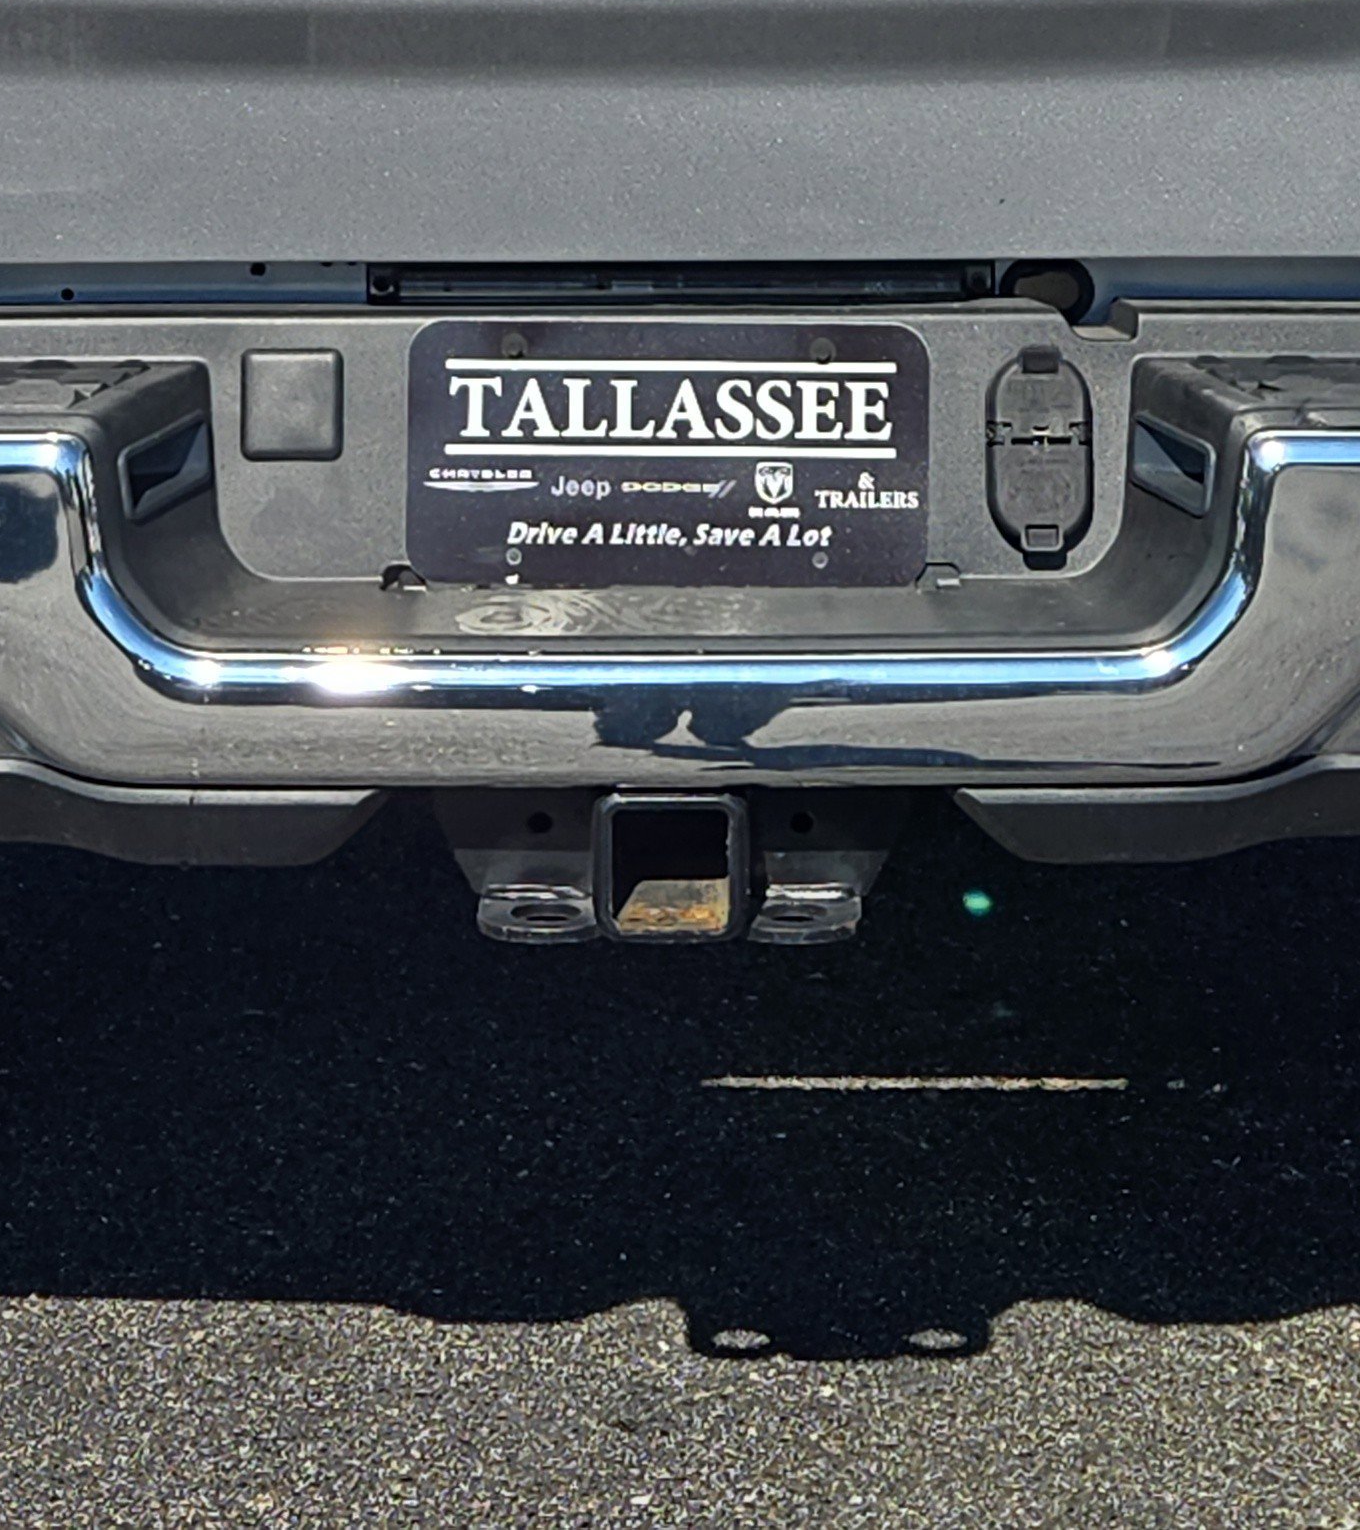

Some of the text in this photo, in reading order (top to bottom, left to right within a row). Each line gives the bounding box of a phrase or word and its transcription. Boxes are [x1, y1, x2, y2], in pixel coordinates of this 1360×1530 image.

[448, 376, 894, 441] TALLASSEE
[550, 476, 612, 500] Jeep
[857, 472, 876, 490] &
[814, 489, 920, 510] TRAILERS
[506, 521, 834, 547] Drive A Little, Save A Lot
